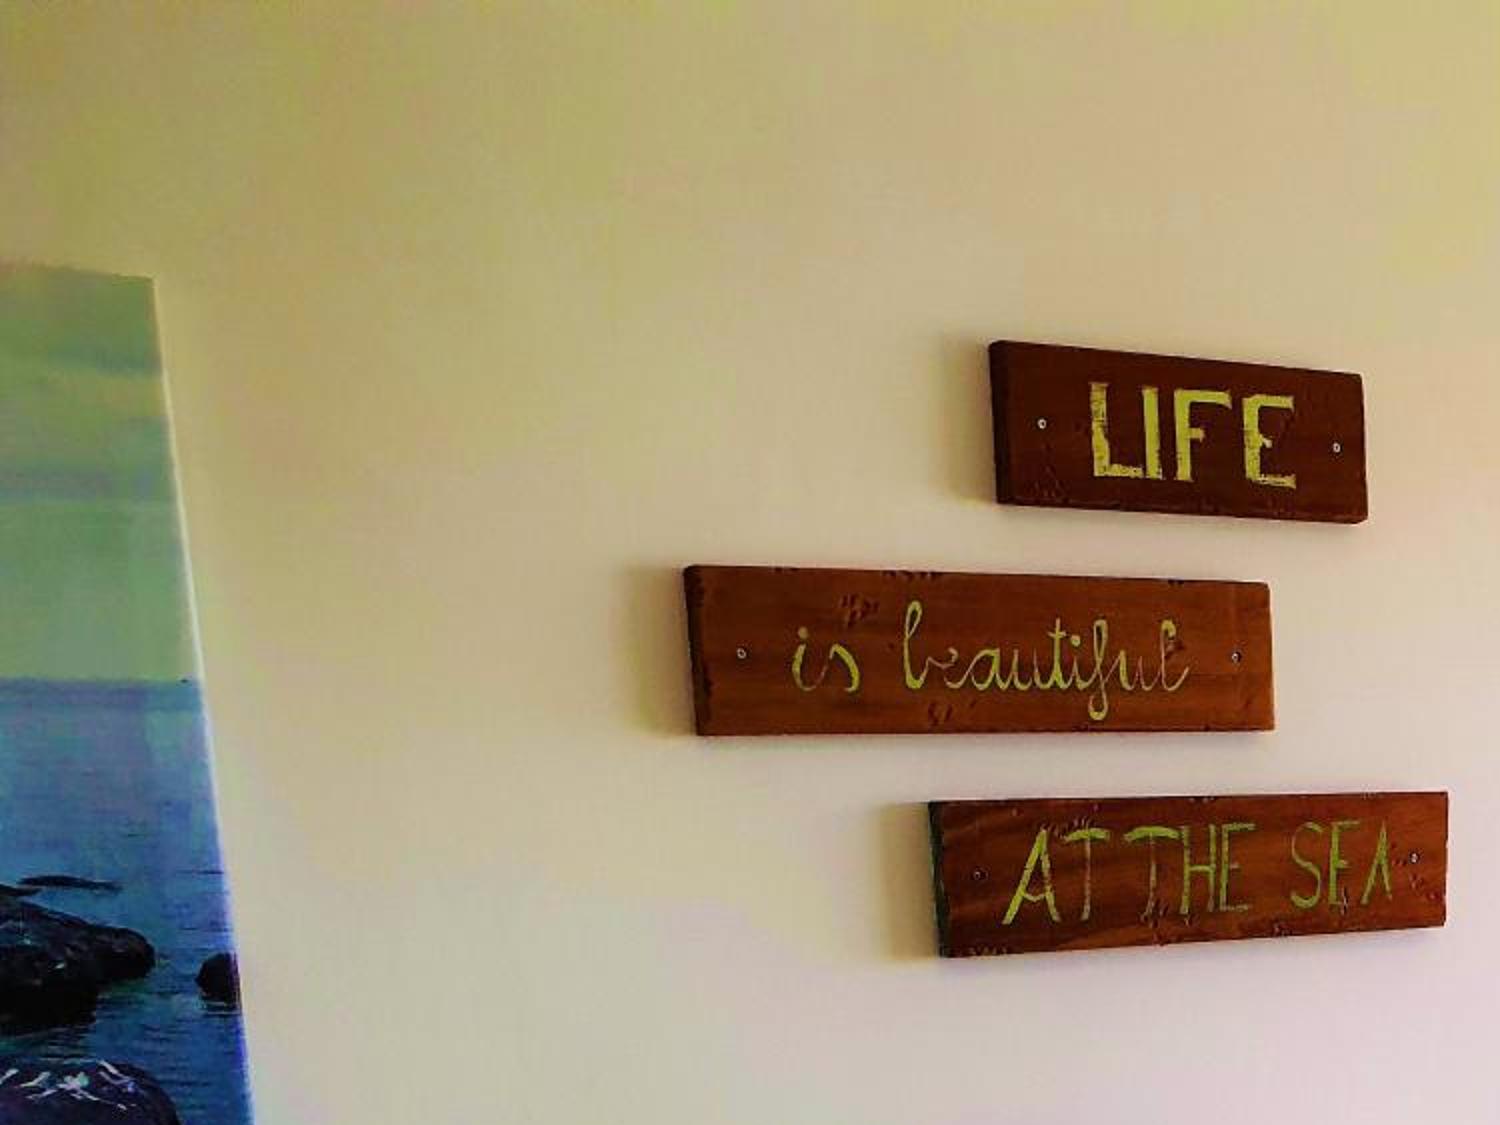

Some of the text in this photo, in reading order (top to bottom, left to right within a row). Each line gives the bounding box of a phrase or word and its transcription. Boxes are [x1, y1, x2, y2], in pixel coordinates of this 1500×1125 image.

[1089, 381, 1297, 488] LIFE
[790, 600, 1190, 720] is beautiful
[1001, 819, 1393, 926] AT THE SEA
